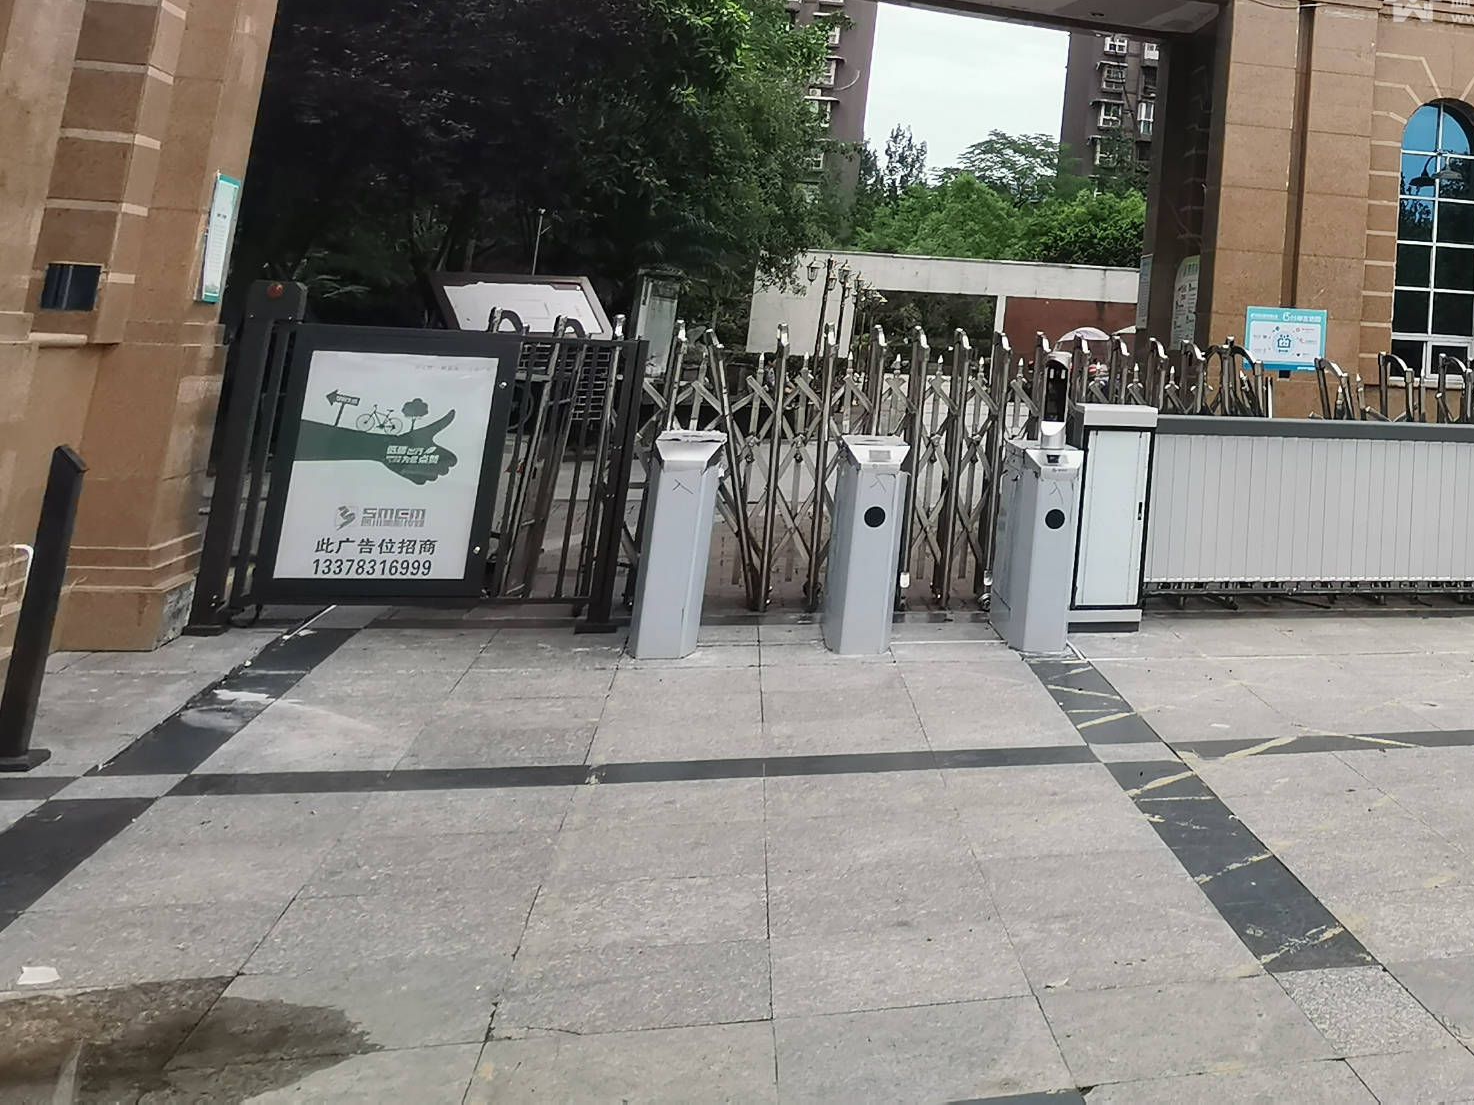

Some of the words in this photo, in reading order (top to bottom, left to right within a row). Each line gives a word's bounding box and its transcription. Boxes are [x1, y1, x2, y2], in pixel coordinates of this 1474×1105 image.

[314, 537, 438, 555] 此广告位招商
[312, 558, 433, 576] 13378316999
